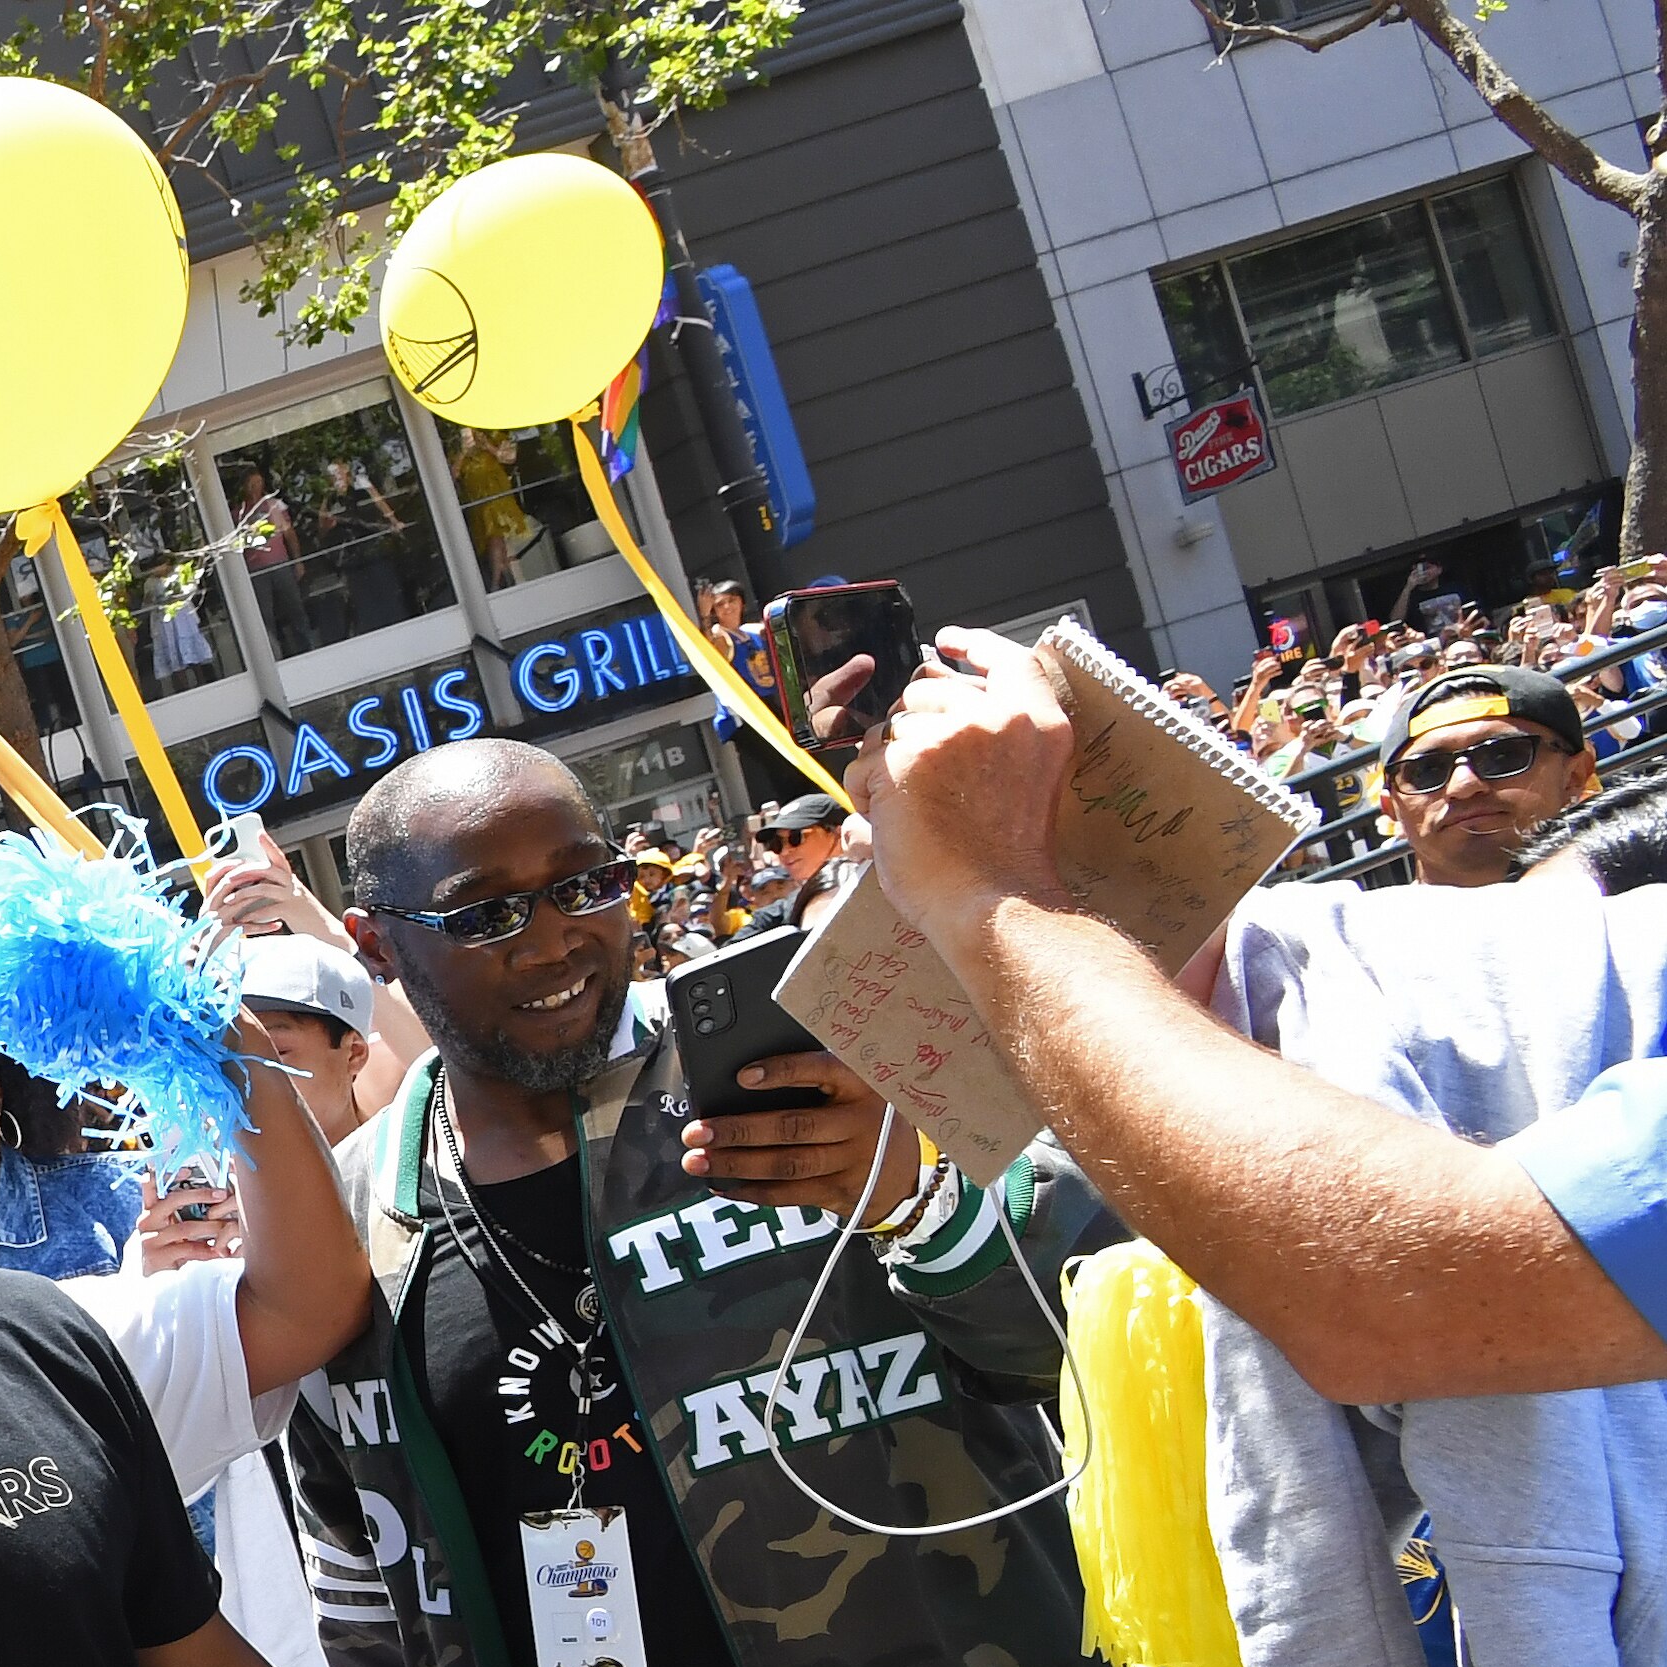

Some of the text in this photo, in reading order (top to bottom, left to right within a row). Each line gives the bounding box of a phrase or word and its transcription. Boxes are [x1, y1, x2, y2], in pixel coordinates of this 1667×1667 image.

[1185, 436, 1262, 485] CIGARS
[203, 616, 690, 815] OASIS GRILL
[619, 746, 687, 782] 711B
[659, 1093, 690, 1118] Ra
[683, 1331, 943, 1471] AYAZ
[524, 1411, 644, 1474] ROOT
[536, 1563, 619, 1586] Champions
